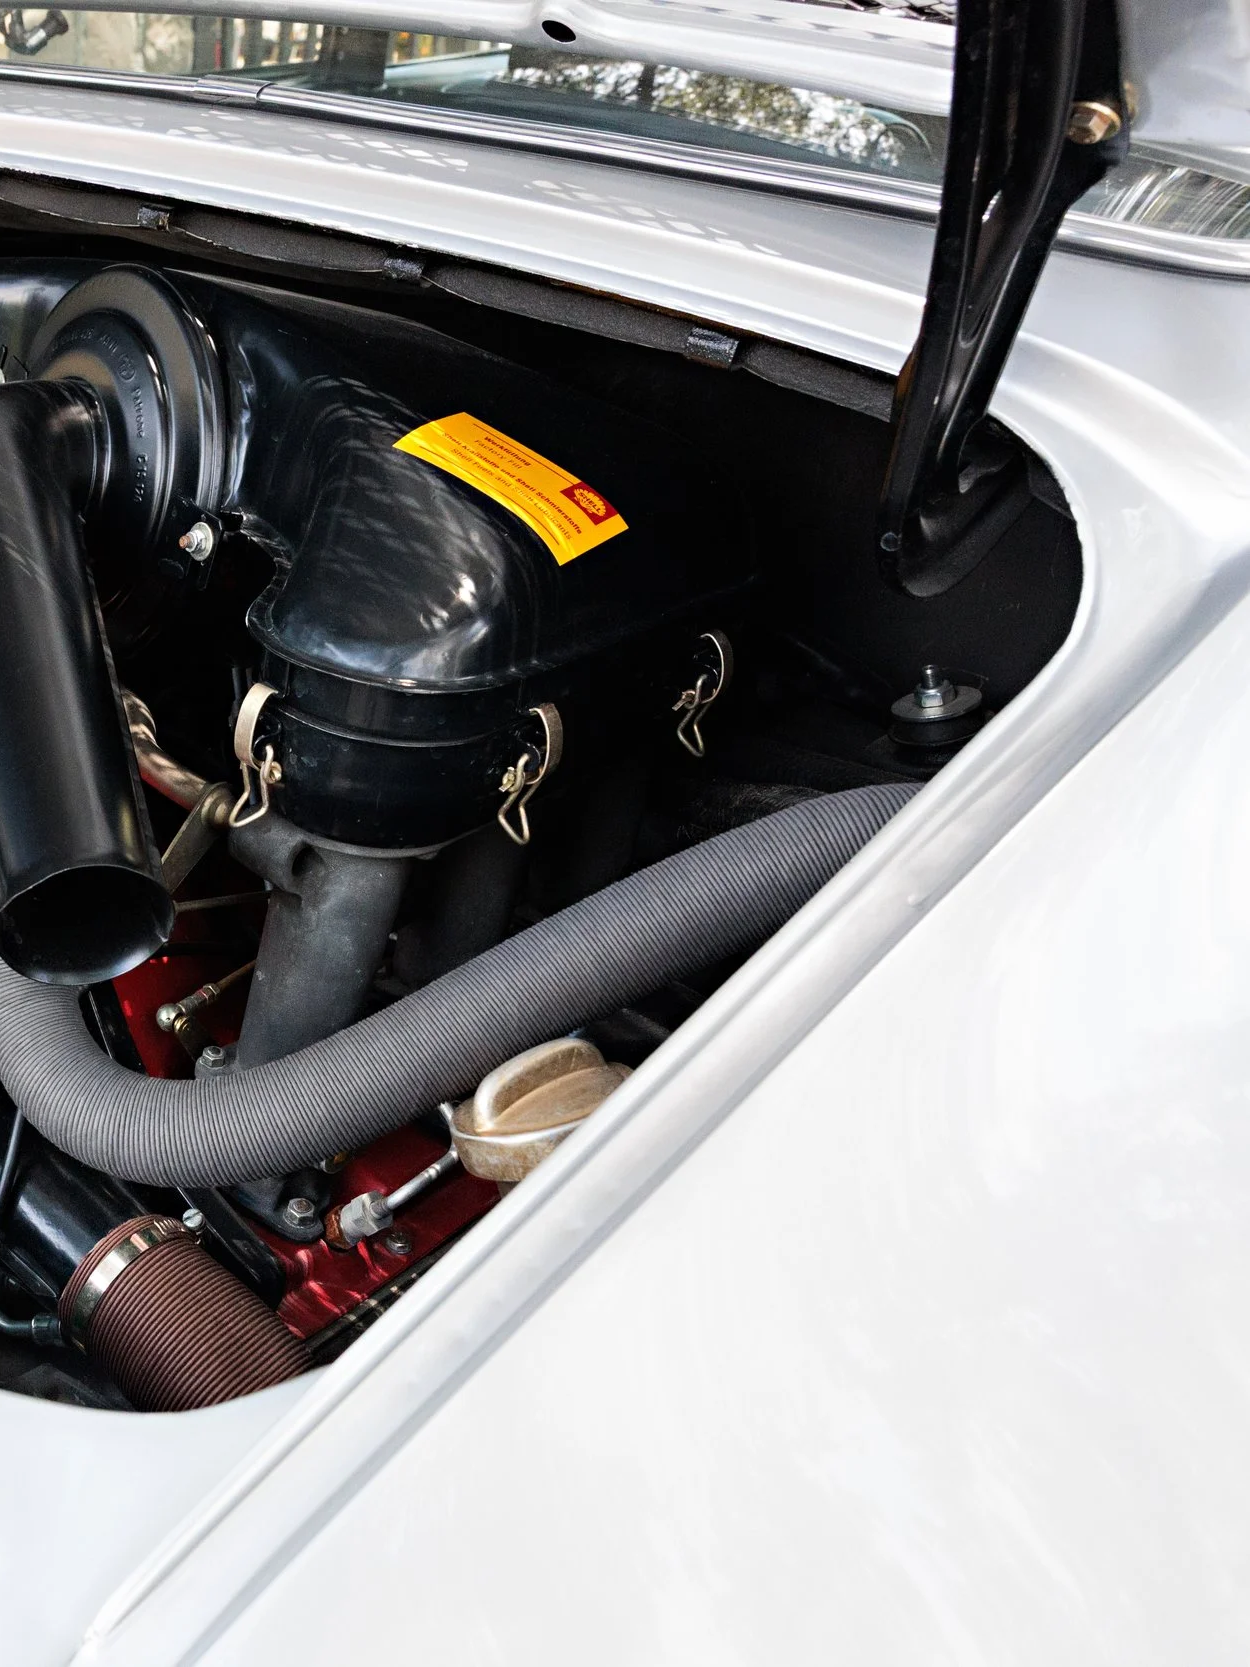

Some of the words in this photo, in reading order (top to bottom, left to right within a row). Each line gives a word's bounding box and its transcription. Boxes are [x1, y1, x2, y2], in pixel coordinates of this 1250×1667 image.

[445, 433, 462, 446] Shell
[500, 469, 516, 478] und
[516, 478, 536, 492] Shell
[536, 491, 582, 534] Schmierstoffe
[474, 440, 504, 459] Factory
[508, 460, 523, 469] Fill
[452, 449, 472, 462] Shell
[473, 462, 494, 476] Fuels
[495, 477, 511, 487] and
[534, 502, 572, 540] Lubricants
[579, 492, 602, 513] SHELL
